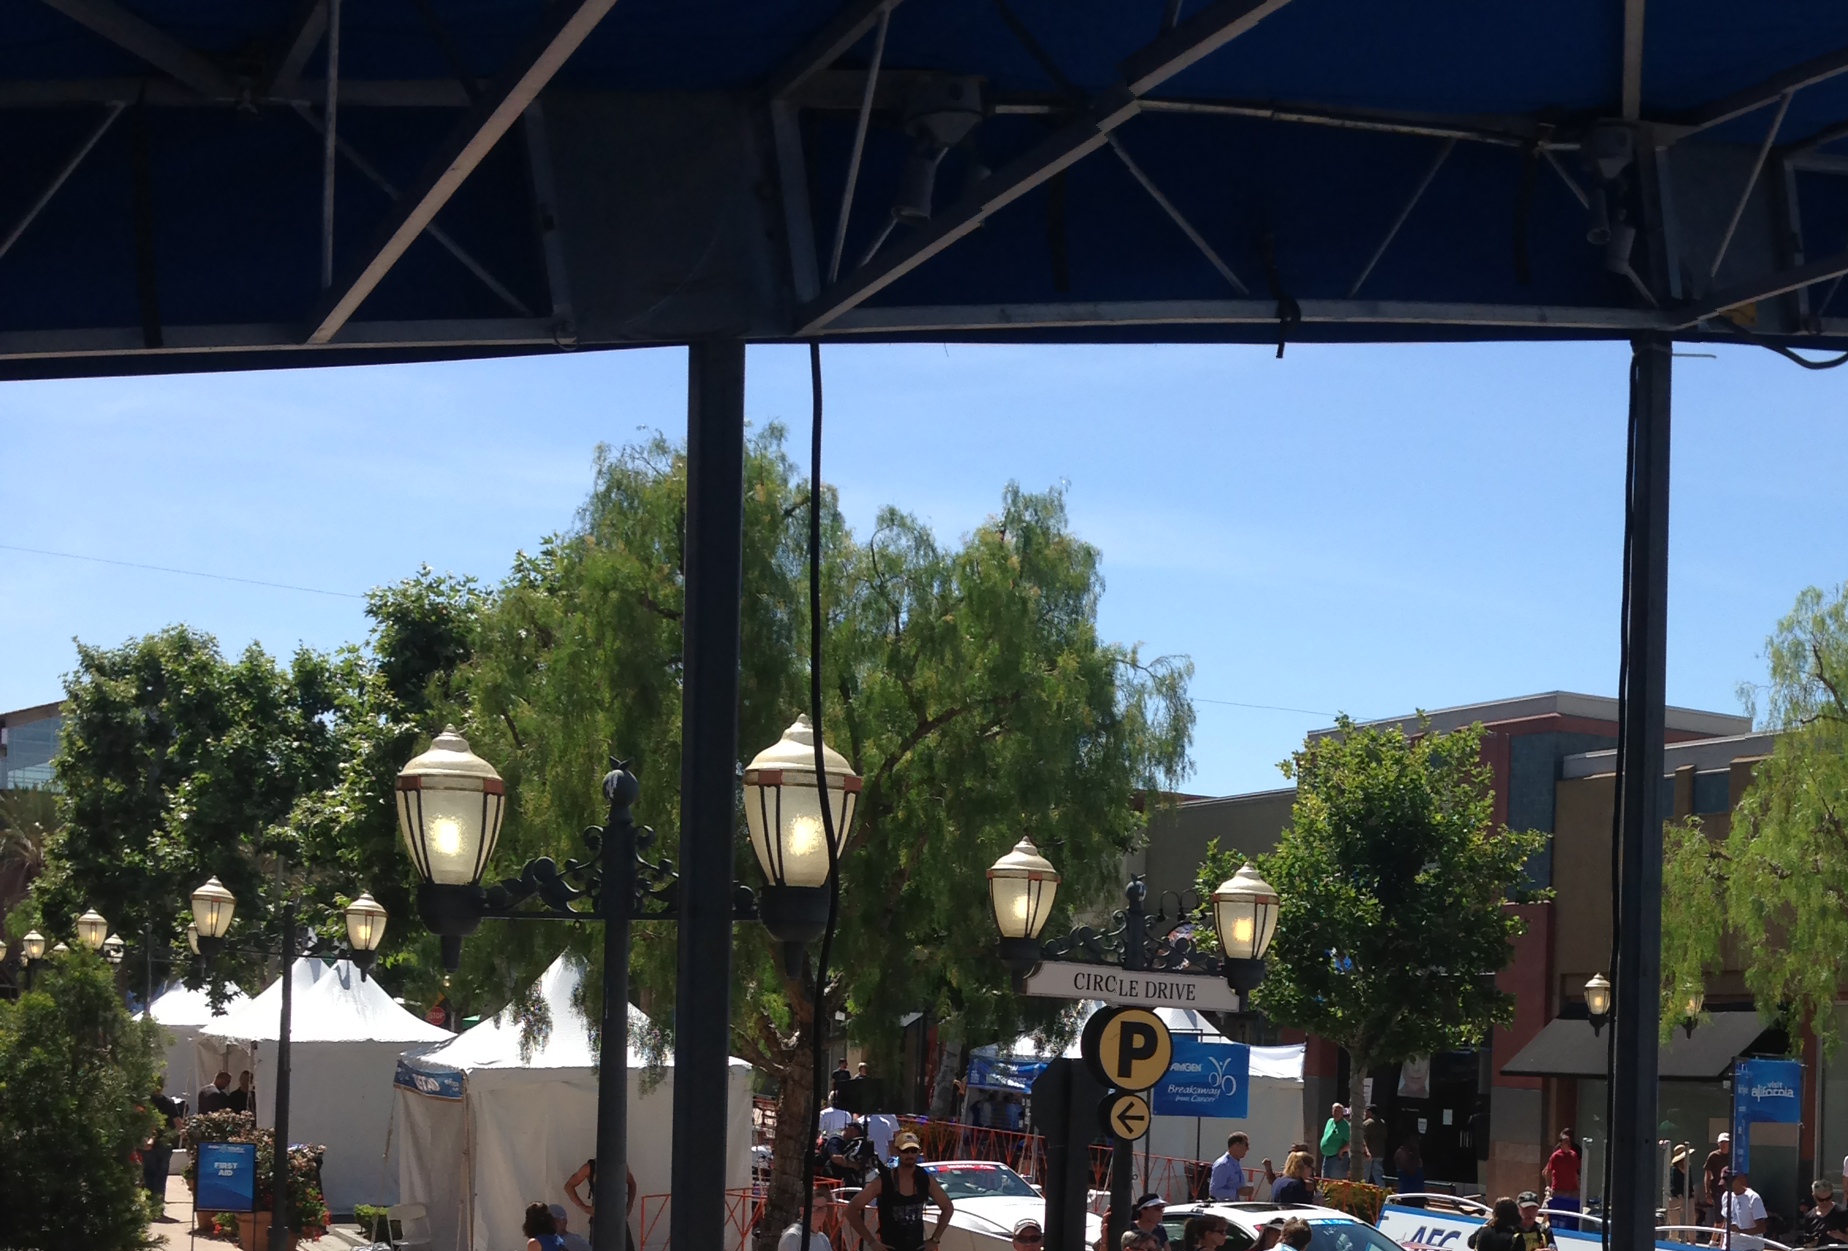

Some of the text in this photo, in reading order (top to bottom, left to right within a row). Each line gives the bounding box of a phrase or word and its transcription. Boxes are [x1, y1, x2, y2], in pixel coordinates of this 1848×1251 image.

[1073, 972, 1196, 1001] CIRCLE DRIVE
[1117, 1021, 1158, 1078] P
[1168, 1084, 1221, 1098] Breakaway
[1751, 1085, 1794, 1101] alifornia
[218, 1169, 233, 1177] AID
